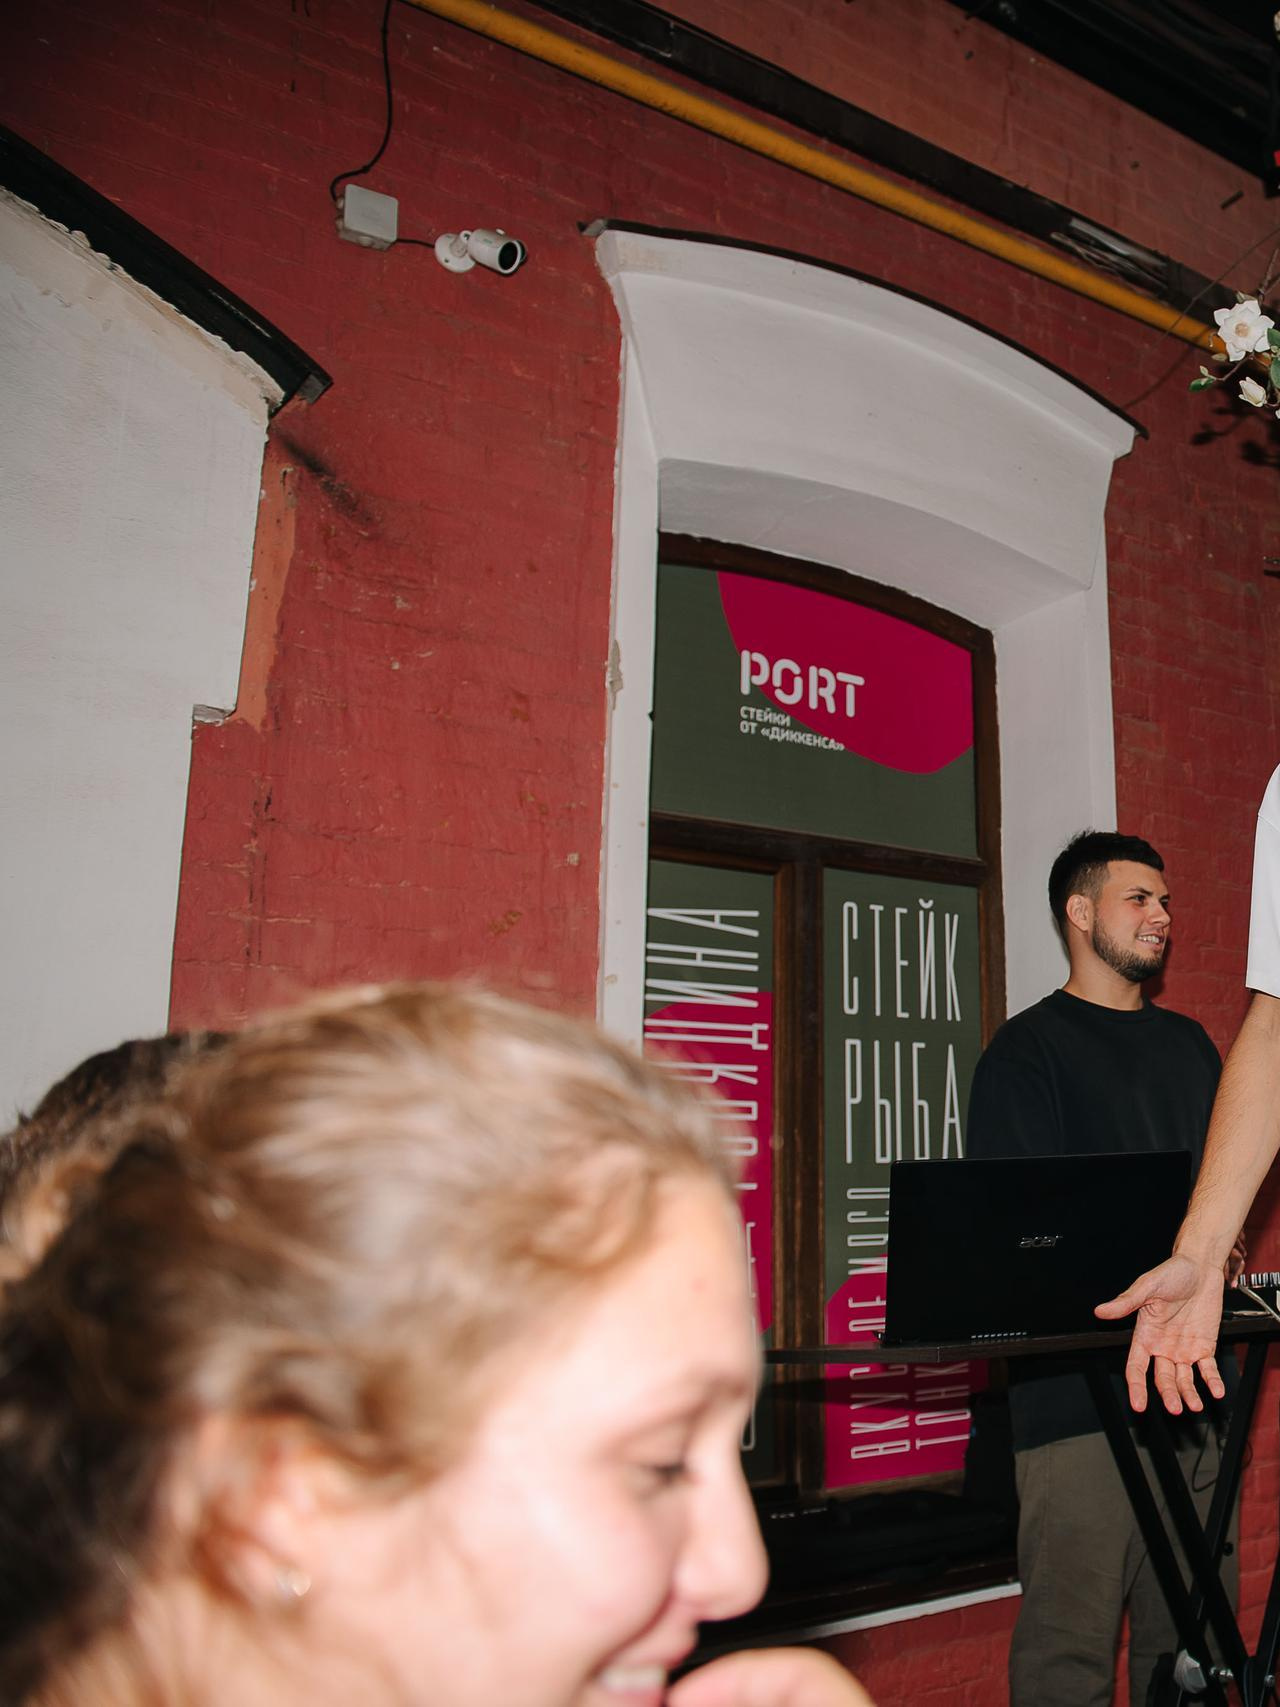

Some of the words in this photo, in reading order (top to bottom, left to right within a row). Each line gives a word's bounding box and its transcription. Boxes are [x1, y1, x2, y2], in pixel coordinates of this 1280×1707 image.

[739, 705, 791, 727] СТЕЙКИ
[740, 649, 865, 718] PORT
[739, 721, 758, 735] ОТ
[760, 726, 845, 751] «ДИККЕНСА»
[842, 898, 962, 1022] СТЕЙК
[844, 1038, 964, 1165] РЫБА
[848, 1295, 911, 1460] ВКУСОЕ
